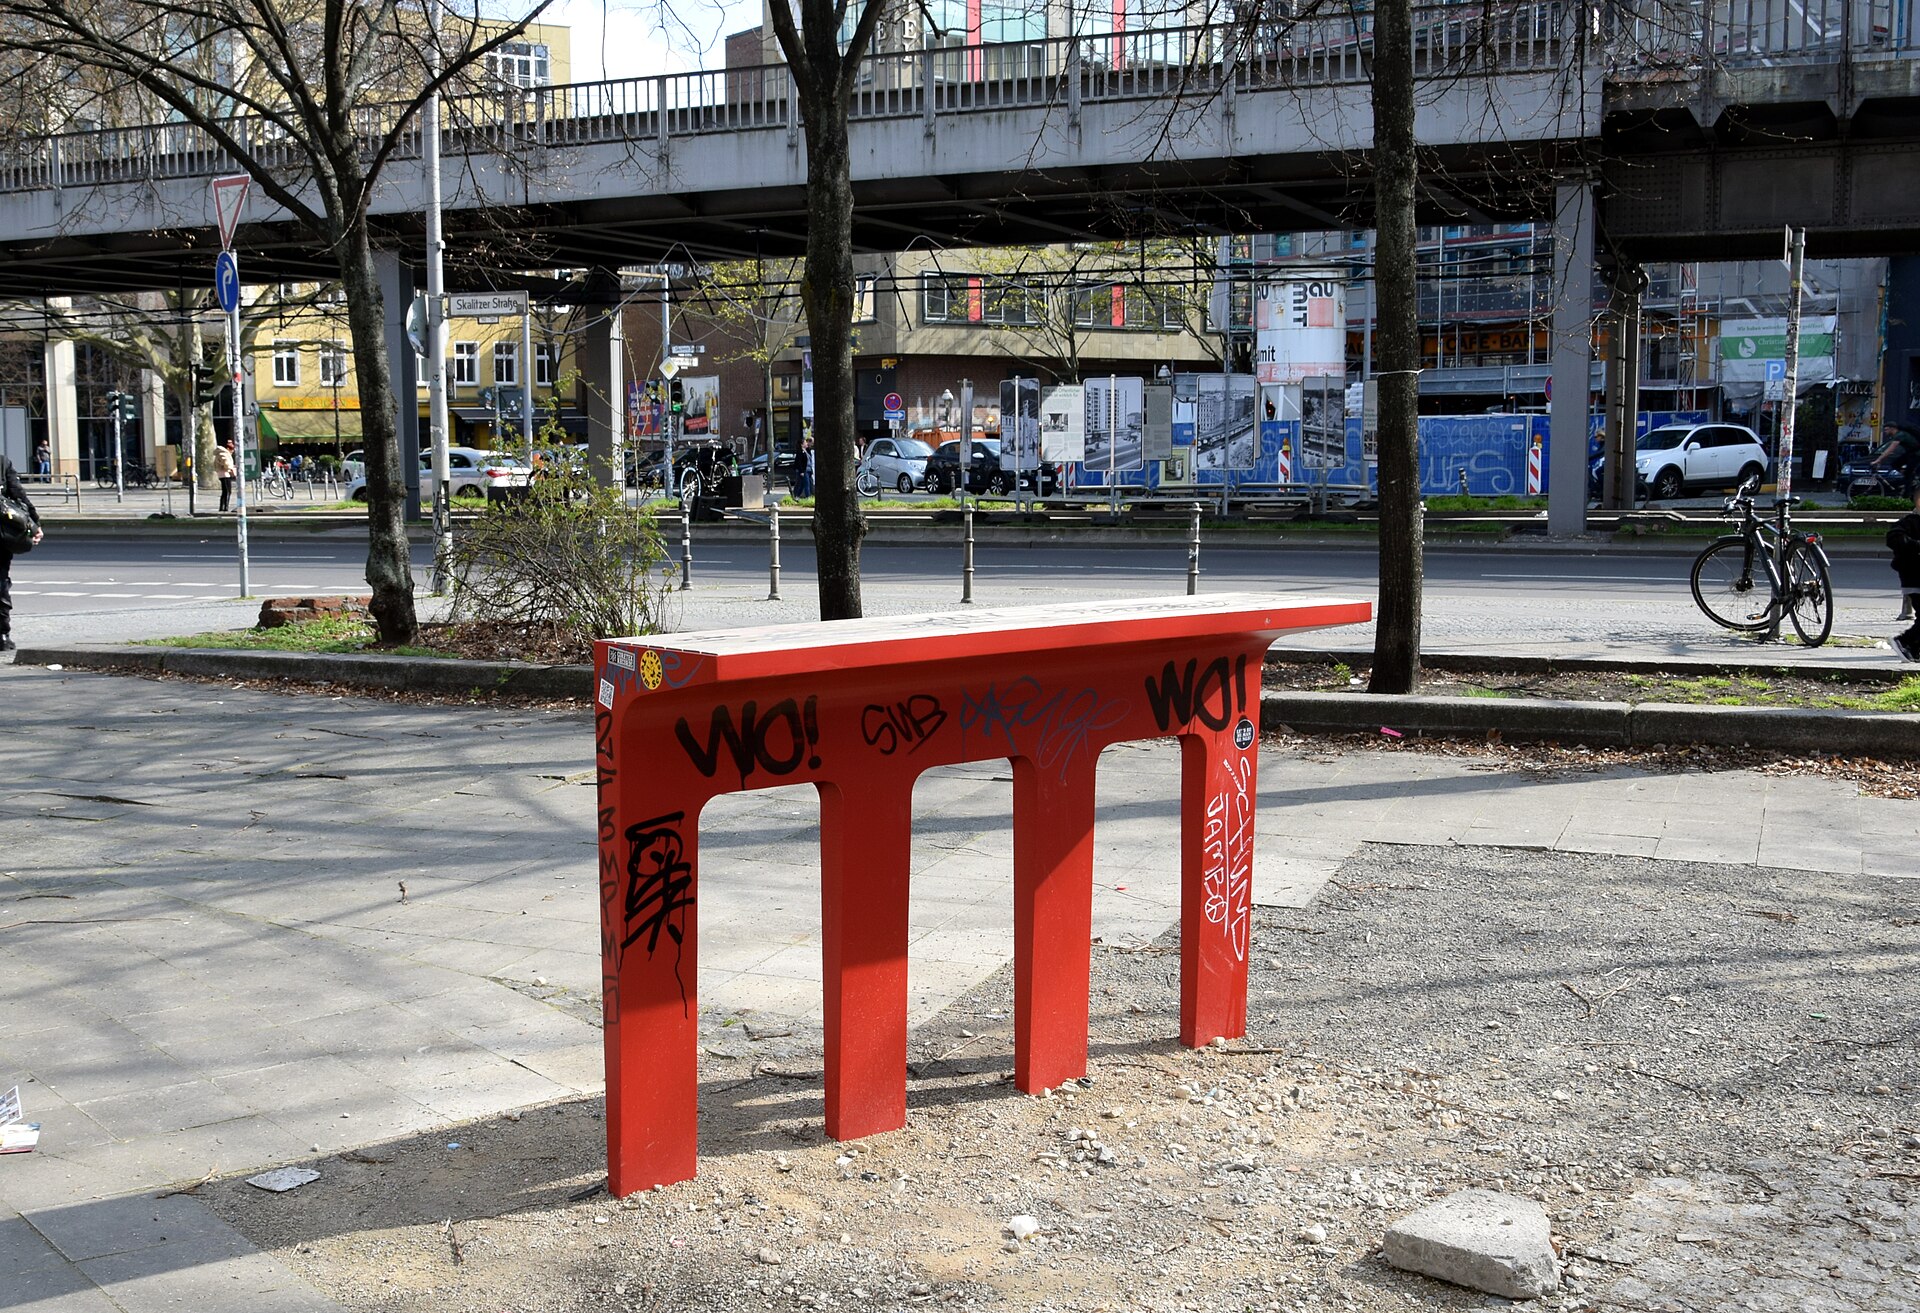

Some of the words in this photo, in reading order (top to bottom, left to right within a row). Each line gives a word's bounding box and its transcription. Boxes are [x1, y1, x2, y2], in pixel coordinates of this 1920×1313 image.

[456, 298, 491, 310] Skalitzer
[492, 297, 518, 310] Straße
[1769, 363, 1781, 381] P
[282, 399, 304, 408] MISS
[674, 694, 823, 778] WO!
